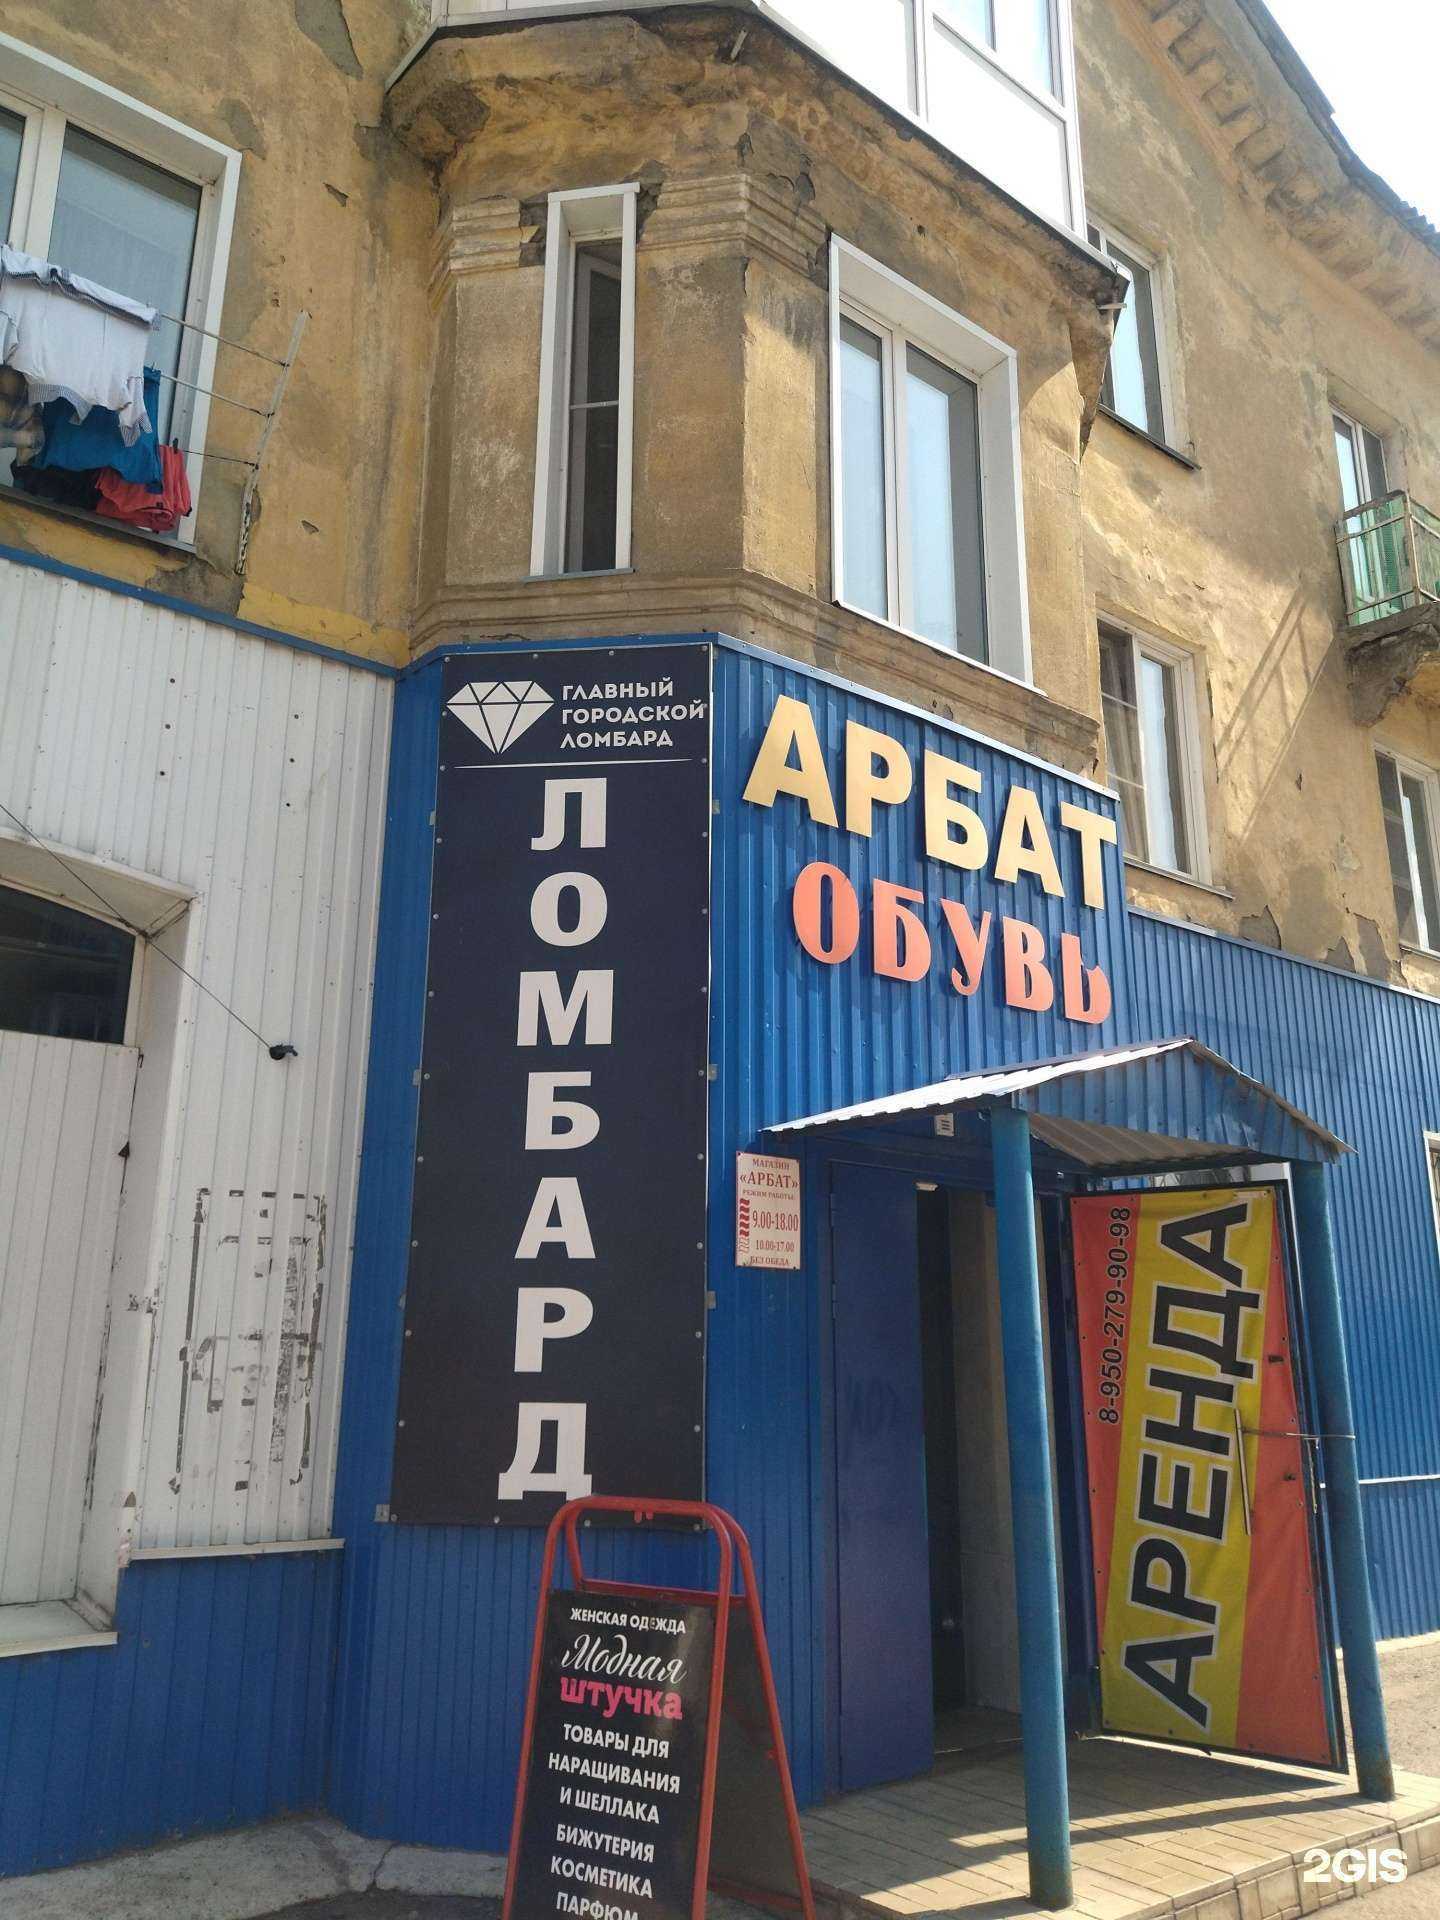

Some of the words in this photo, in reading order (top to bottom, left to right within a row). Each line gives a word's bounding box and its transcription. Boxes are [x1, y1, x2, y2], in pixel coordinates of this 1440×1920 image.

[563, 677, 673, 700] ГЛАВНЫЙ
[562, 699, 705, 725] ГОРОДСКОЙ
[560, 729, 673, 749] ЛОМБАРД
[743, 694, 1117, 910] АРБАТ
[793, 861, 1112, 1025] ОБУВЬ
[498, 777, 614, 1500] ЛОМБАРД
[740, 1170, 799, 1189] «АРБАТ»
[752, 1210, 799, 1232] 9.00-18.00
[1099, 1207, 1131, 1424] 8-950-279-90-98
[1124, 1202, 1260, 1729] АРЕНДА
[570, 1607, 627, 1627] ЖЕНСКАЯ
[561, 1633, 687, 1684] Модная
[563, 1723, 629, 1751] ТОВАРЫ
[632, 1736, 670, 1759] ДЛЯ
[549, 1752, 681, 1794] НАРАЩИВАНИЯ
[559, 1786, 572, 1804] И
[575, 1788, 660, 1824] ШЕЛЛАКА
[556, 1823, 655, 1863] БИЖУТЕРИЯ
[550, 1855, 653, 1899] КОСМЕТИКА
